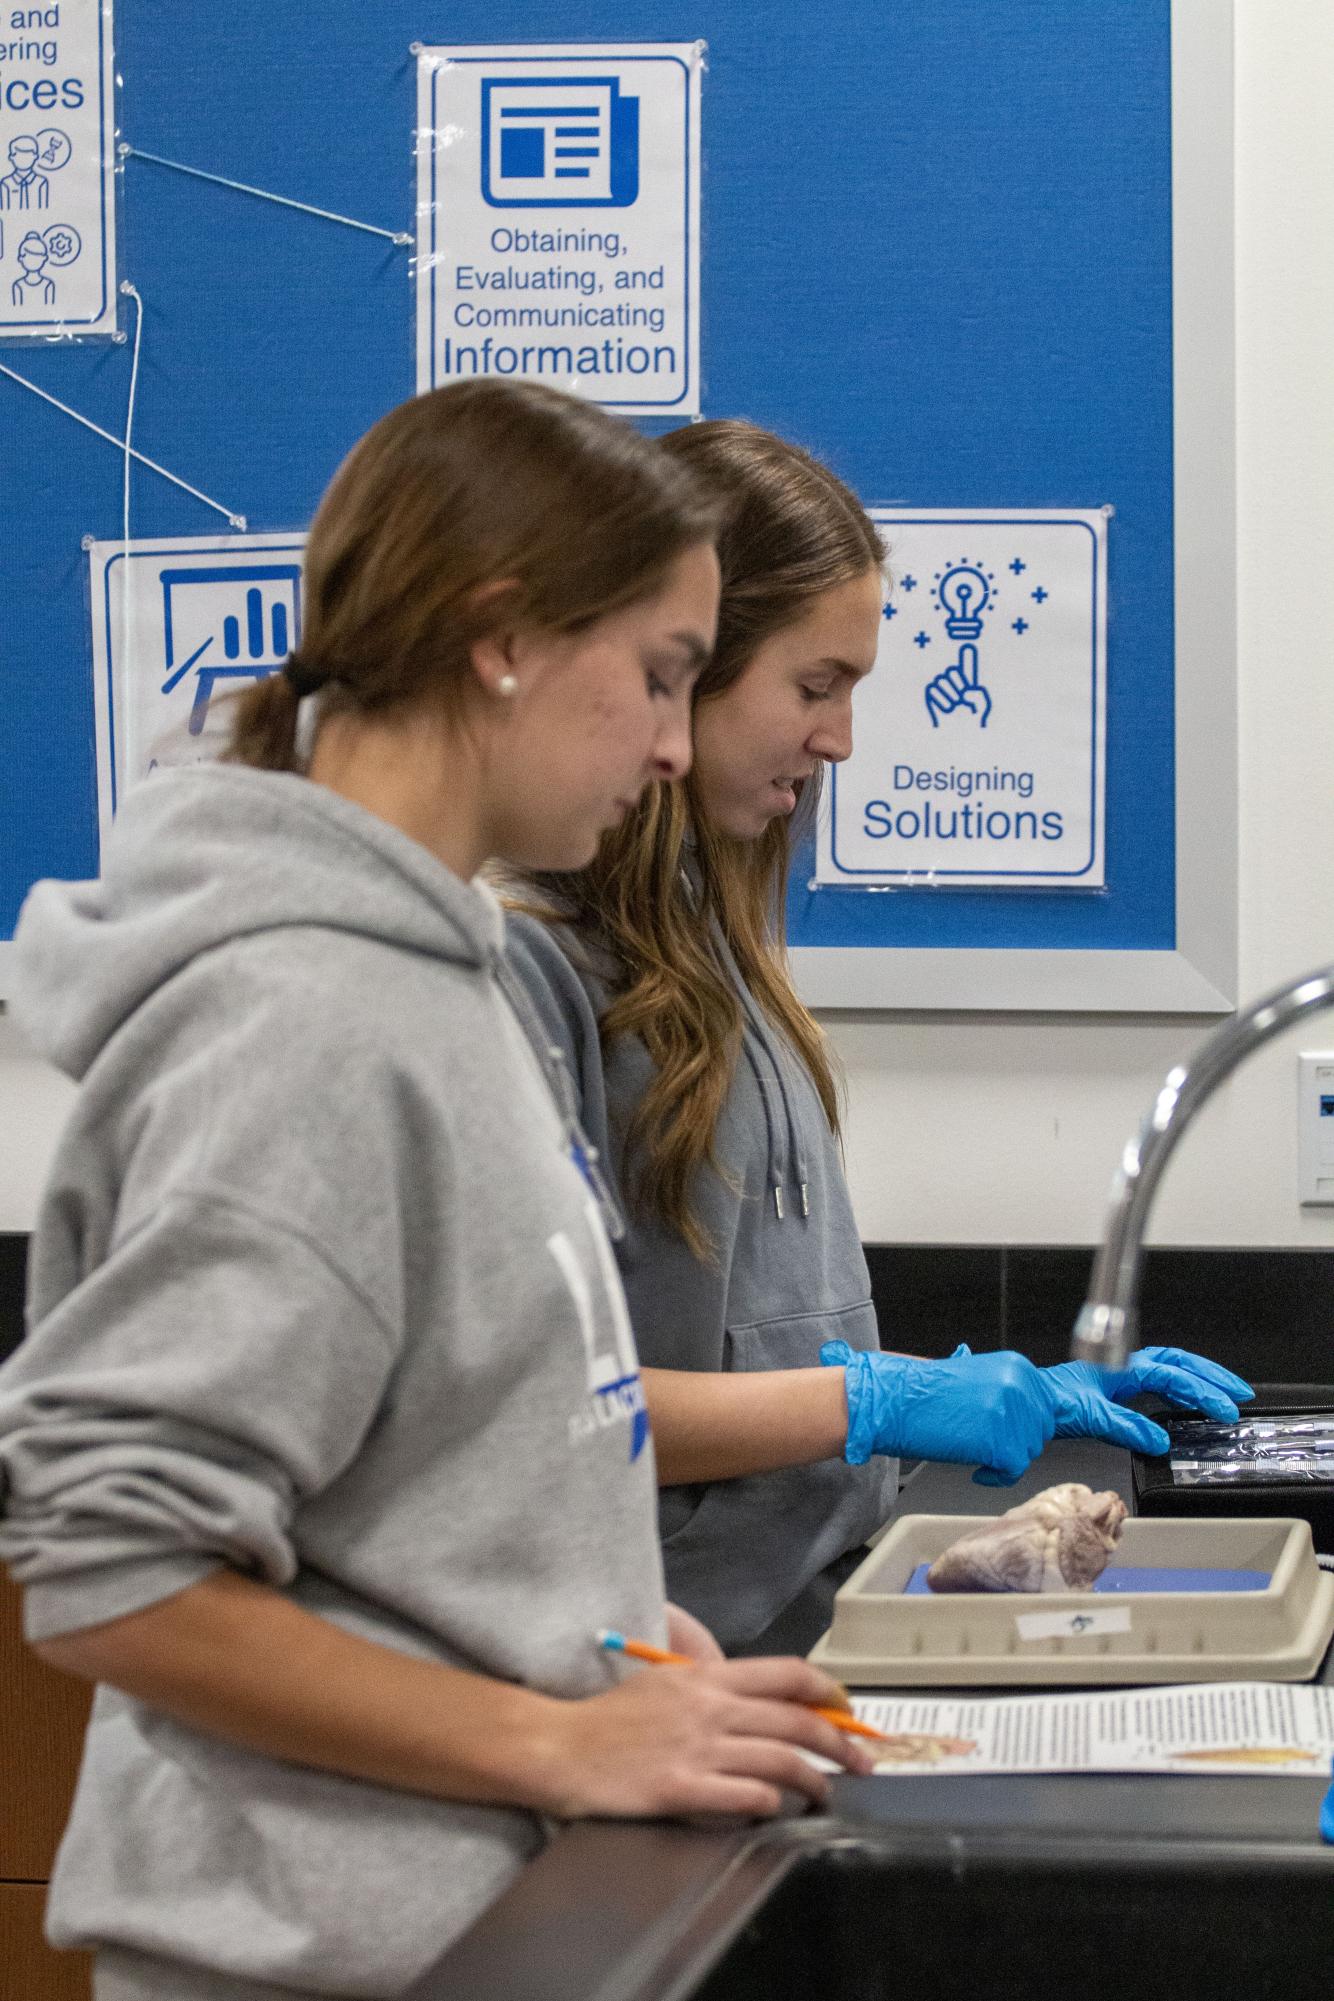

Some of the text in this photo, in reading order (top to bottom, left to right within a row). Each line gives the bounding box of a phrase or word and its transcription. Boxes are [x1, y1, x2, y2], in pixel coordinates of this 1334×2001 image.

[11, 4, 59, 29] and
[0, 71, 84, 110] ces
[491, 228, 628, 257] Obtaining,
[456, 265, 665, 295] Evaluating, and
[454, 302, 665, 332] Communicating
[444, 337, 676, 374] Information
[894, 765, 1034, 798] Designing
[863, 800, 1064, 841] Solutions
